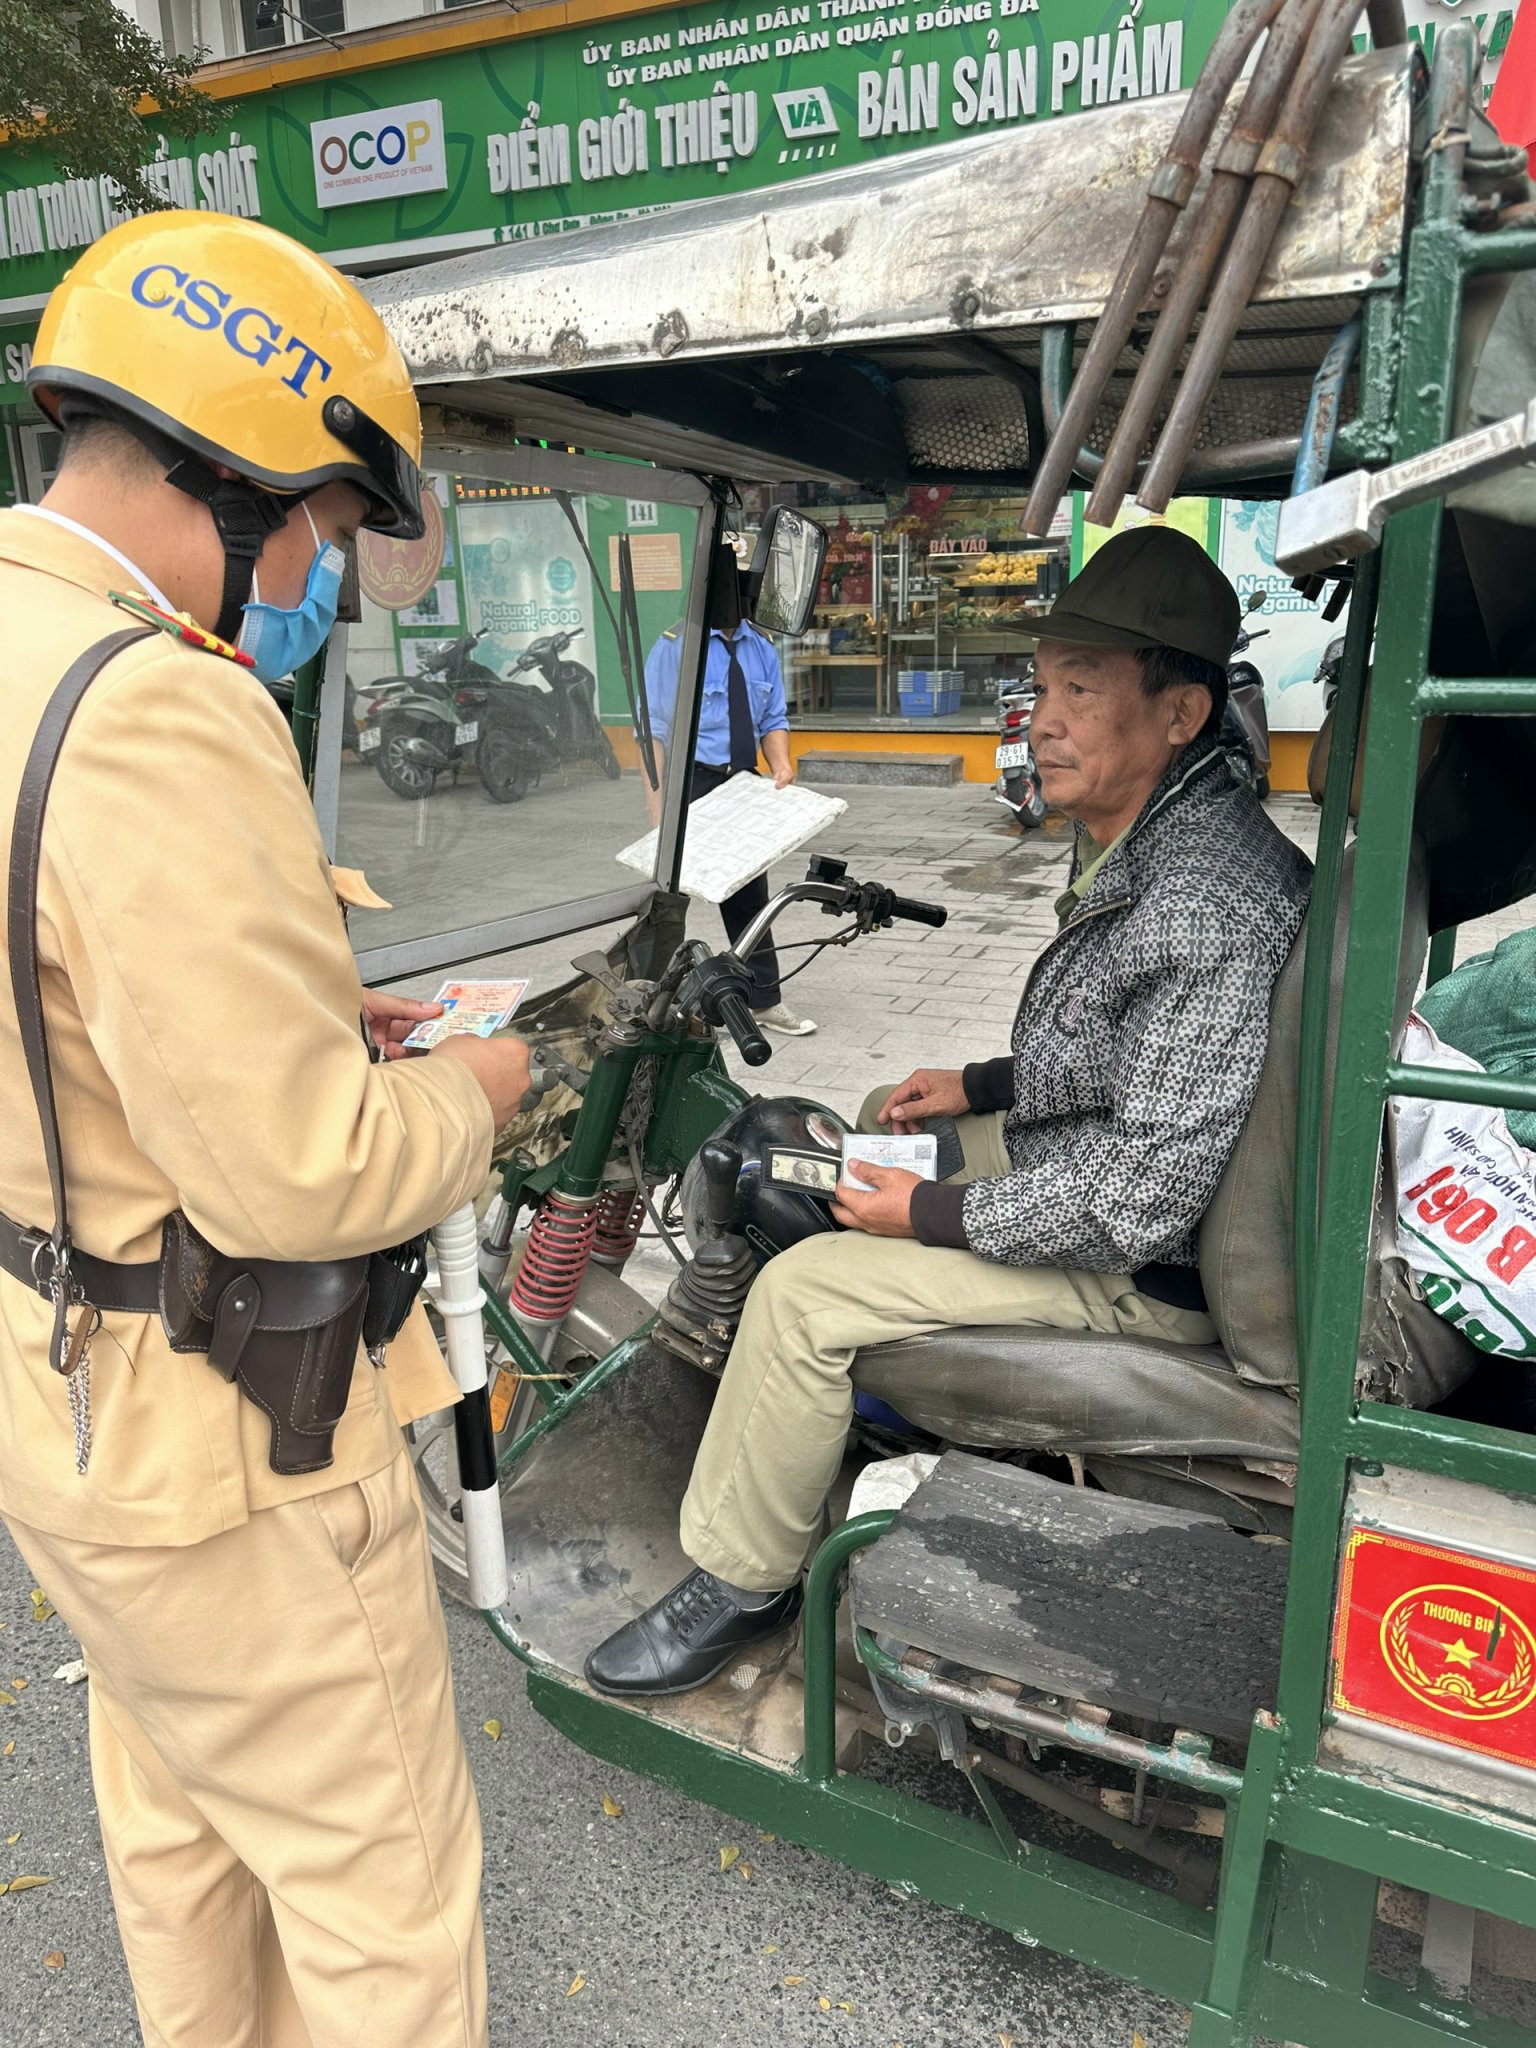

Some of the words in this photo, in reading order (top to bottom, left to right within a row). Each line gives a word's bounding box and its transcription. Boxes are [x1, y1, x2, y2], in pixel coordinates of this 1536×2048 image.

[583, 40, 612, 65] ỦY
[621, 33, 671, 58] BAN
[678, 17, 748, 47] NHÂN
[756, 5, 810, 32] DÂN
[607, 64, 637, 88] ỦY
[641, 57, 692, 83] BAN
[698, 43, 769, 72] NHÂN
[775, 31, 830, 57] DÂN
[836, 16, 909, 46] QUẬN
[916, 0, 992, 32] ĐỐNG
[487, 100, 572, 194] ĐIỂM
[578, 97, 649, 182] GIỚI
[655, 80, 758, 175] THIỆU
[787, 94, 825, 129] VÀ
[858, 50, 940, 140] BÁN
[951, 28, 1038, 127] SẢN
[1051, 0, 1184, 112] PHẨM
[320, 120, 431, 175] OCOP
[7, 187, 45, 256] AN
[198, 132, 261, 217] SOÁT
[323, 181, 335, 189] ONE
[335, 175, 362, 188] COMMUNE
[362, 173, 374, 182] ONE
[374, 169, 400, 180] PRODUCT
[400, 168, 409, 177] OF
[409, 164, 433, 174] VIETNAM
[509, 224, 529, 241] 141
[131, 264, 333, 400] CSGT
[630, 503, 655, 522] 141
[481, 600, 536, 617] Natural
[540, 608, 582, 625] FOOD
[482, 617, 540, 634] Organic
[1423, 1600, 1472, 1628] THƯƠNG
